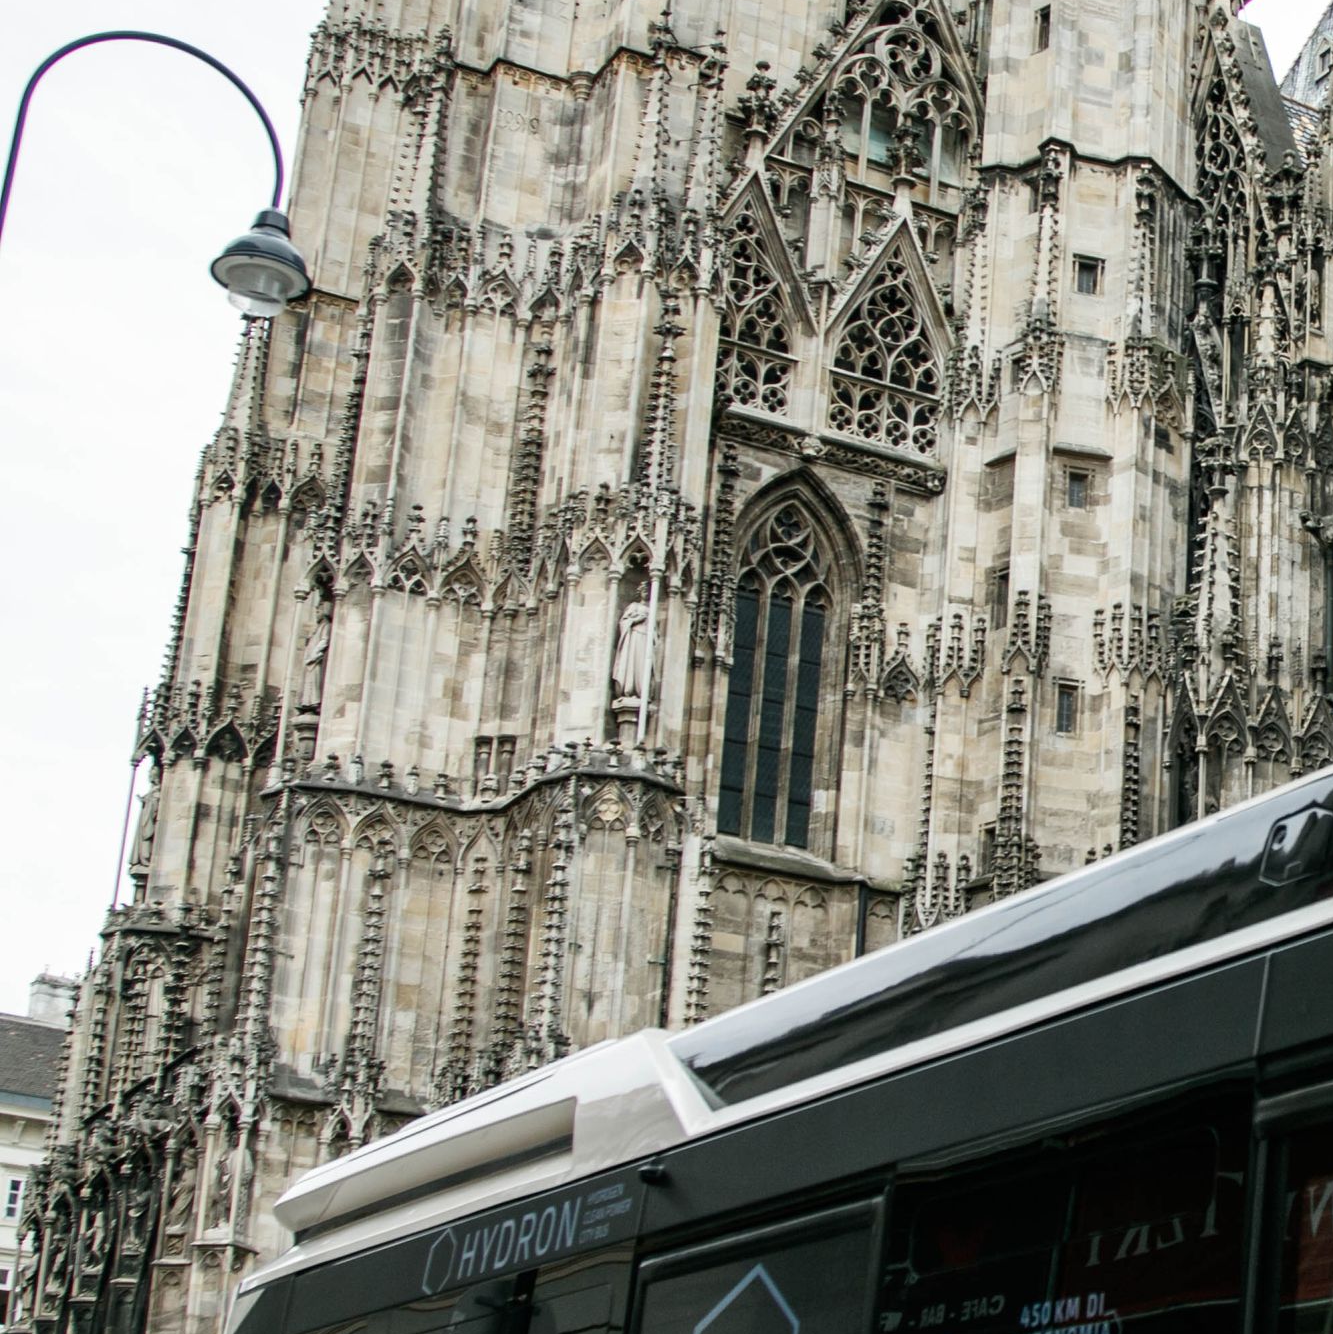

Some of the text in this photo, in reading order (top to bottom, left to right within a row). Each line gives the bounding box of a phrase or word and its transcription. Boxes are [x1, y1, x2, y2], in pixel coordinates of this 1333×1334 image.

[456, 1196, 583, 1281] HYDRON
[1019, 1291, 1107, 1328] 450 KM DI
